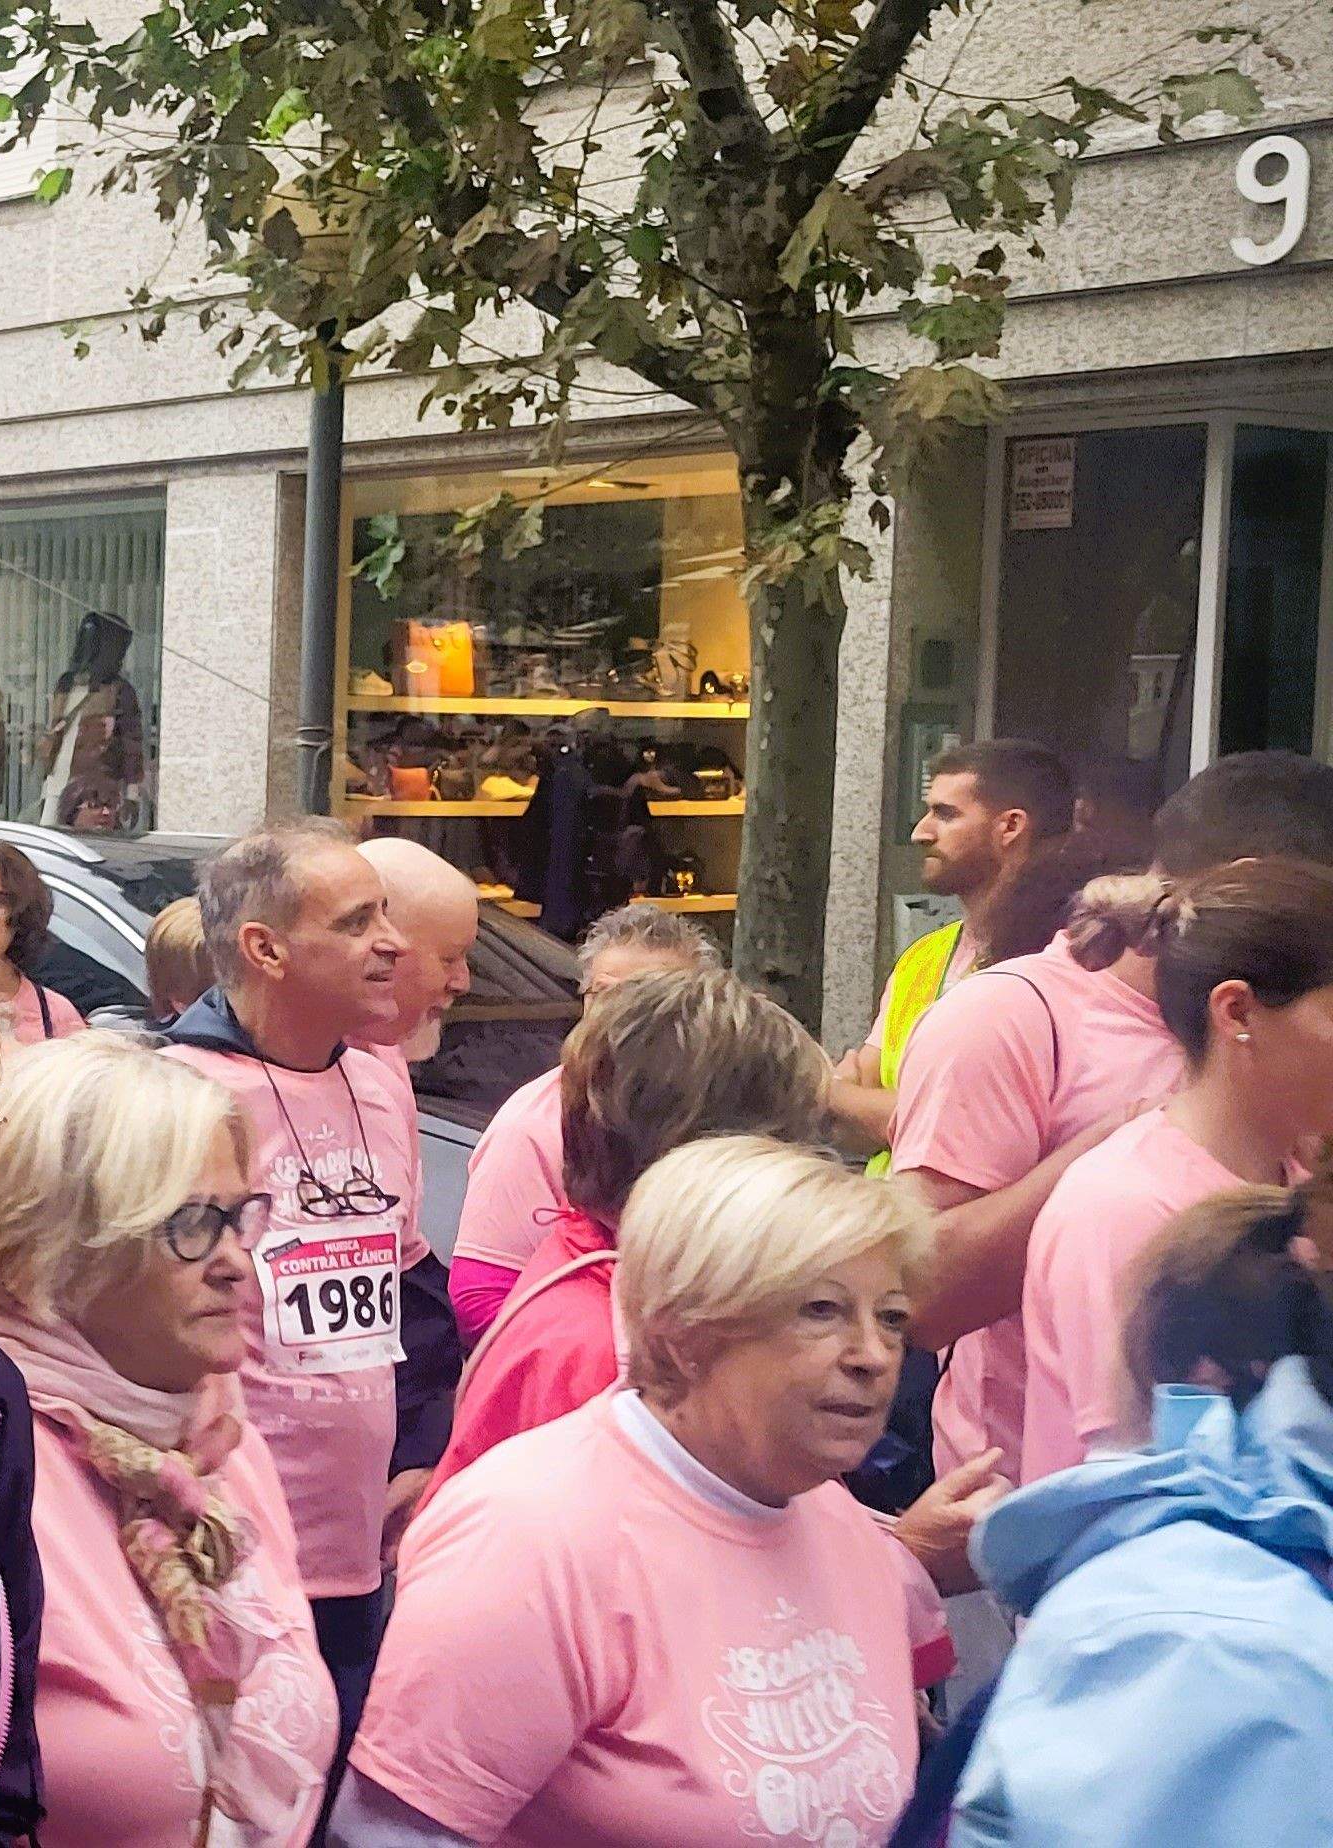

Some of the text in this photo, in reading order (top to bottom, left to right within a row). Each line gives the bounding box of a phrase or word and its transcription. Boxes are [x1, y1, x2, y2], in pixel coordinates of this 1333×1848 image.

[1230, 135, 1311, 266] 9
[278, 1254, 336, 1275] CONTRA
[284, 1271, 394, 1336] 1986
